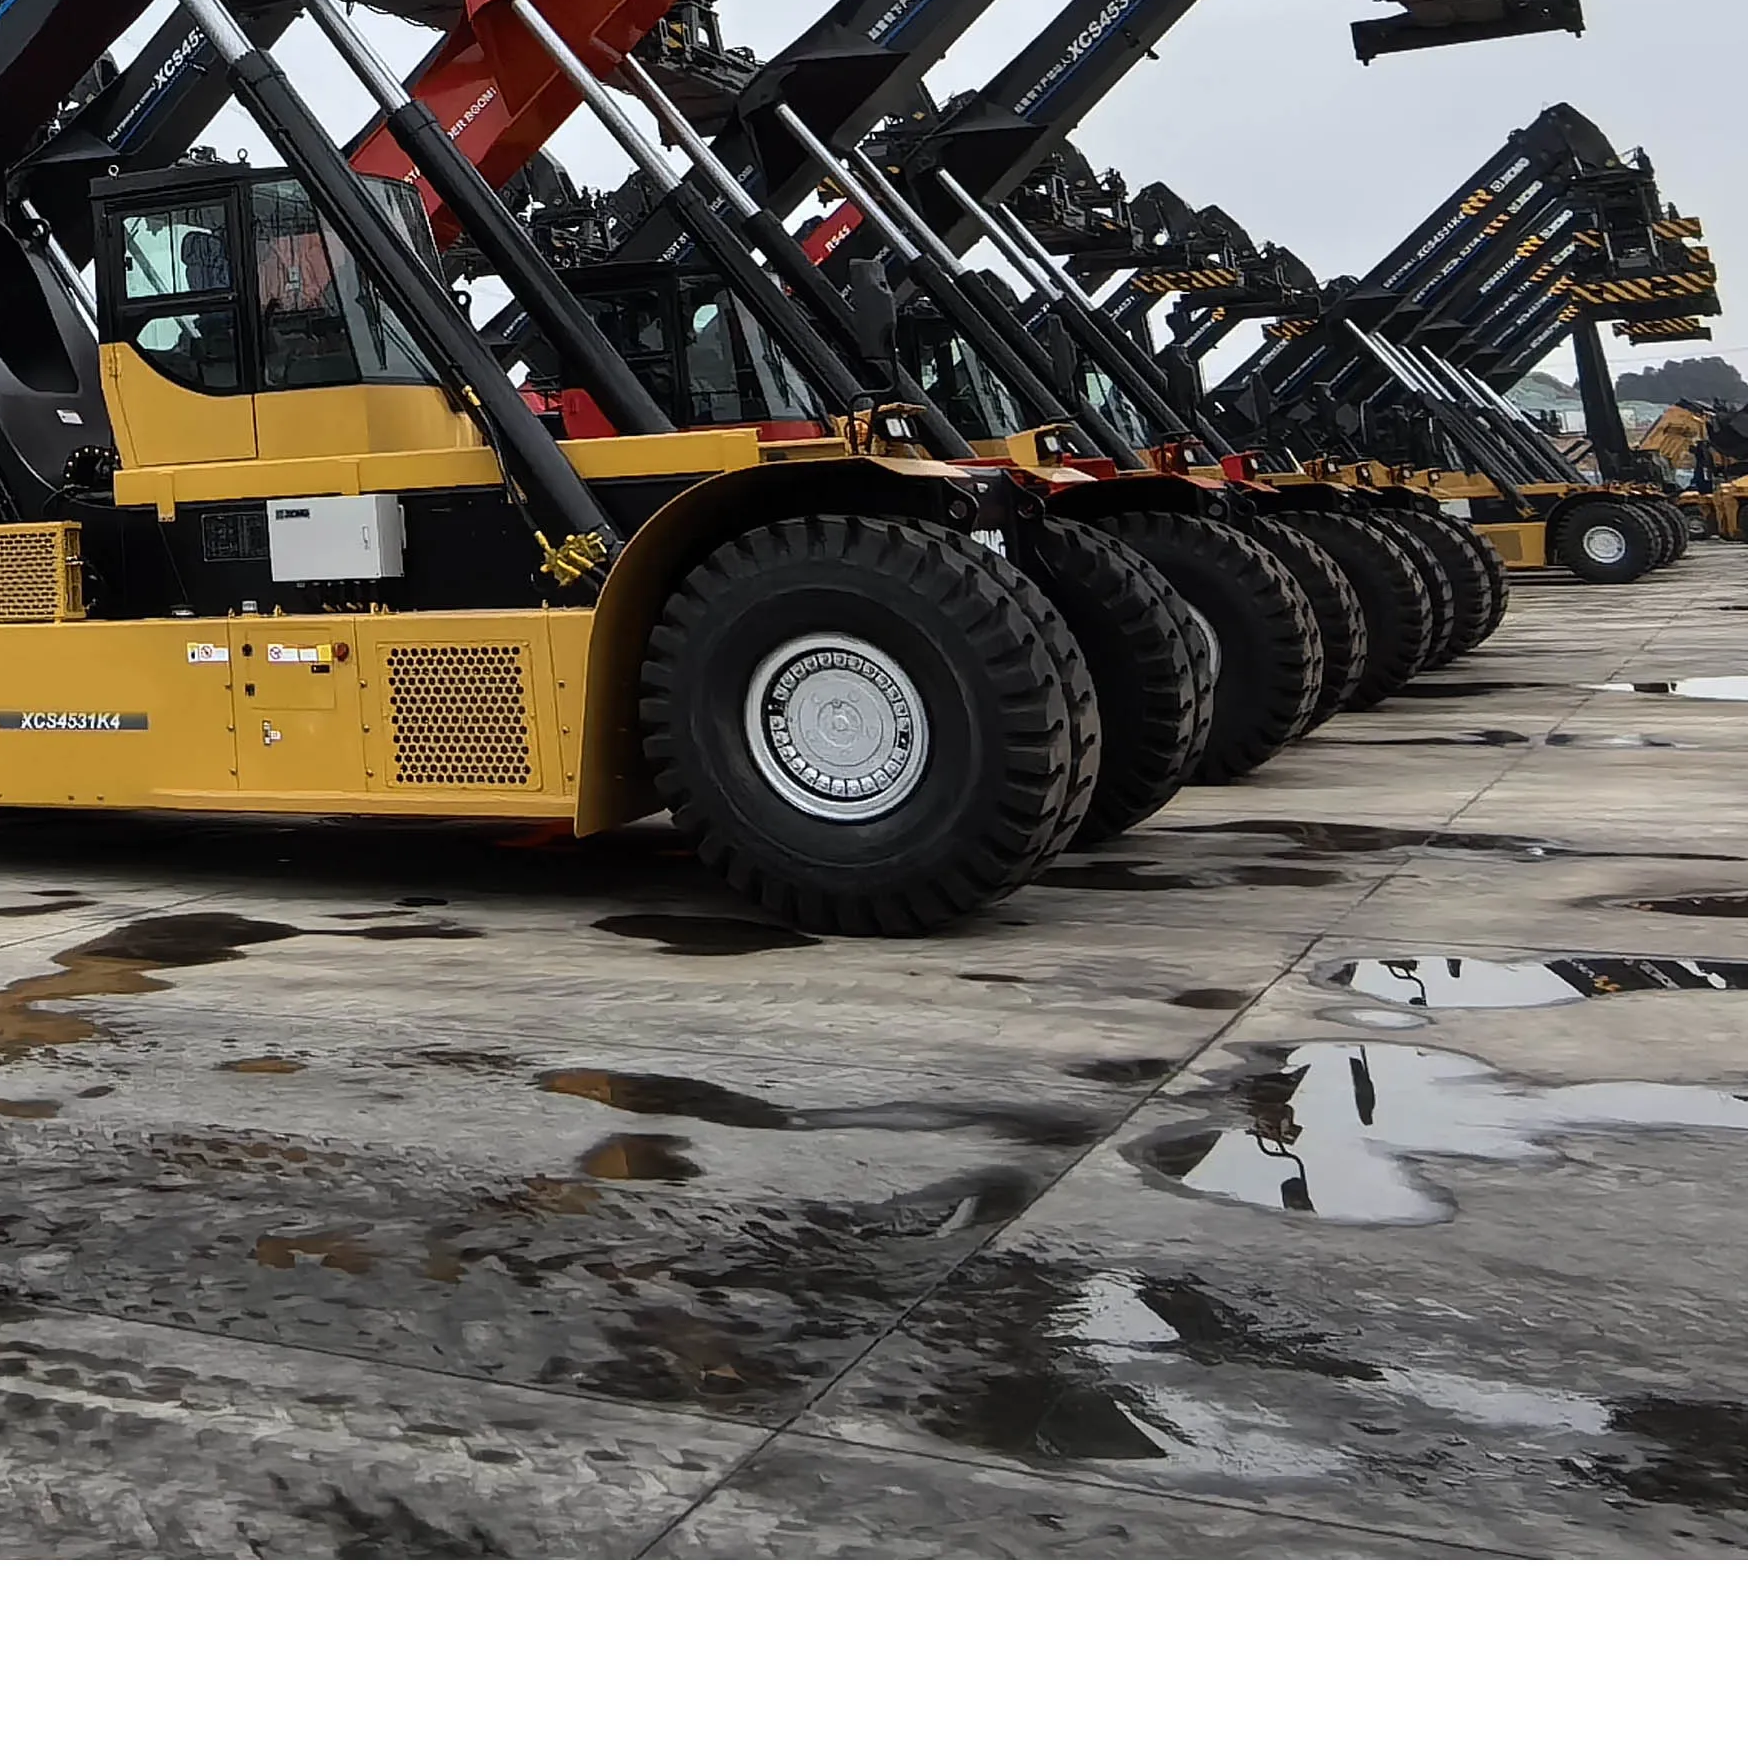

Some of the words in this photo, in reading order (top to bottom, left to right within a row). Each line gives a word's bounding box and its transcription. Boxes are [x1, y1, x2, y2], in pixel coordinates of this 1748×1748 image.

[154, 25, 205, 90] XCS45
[463, 86, 498, 123] BOOM!
[20, 711, 121, 730] XCS4531K4
